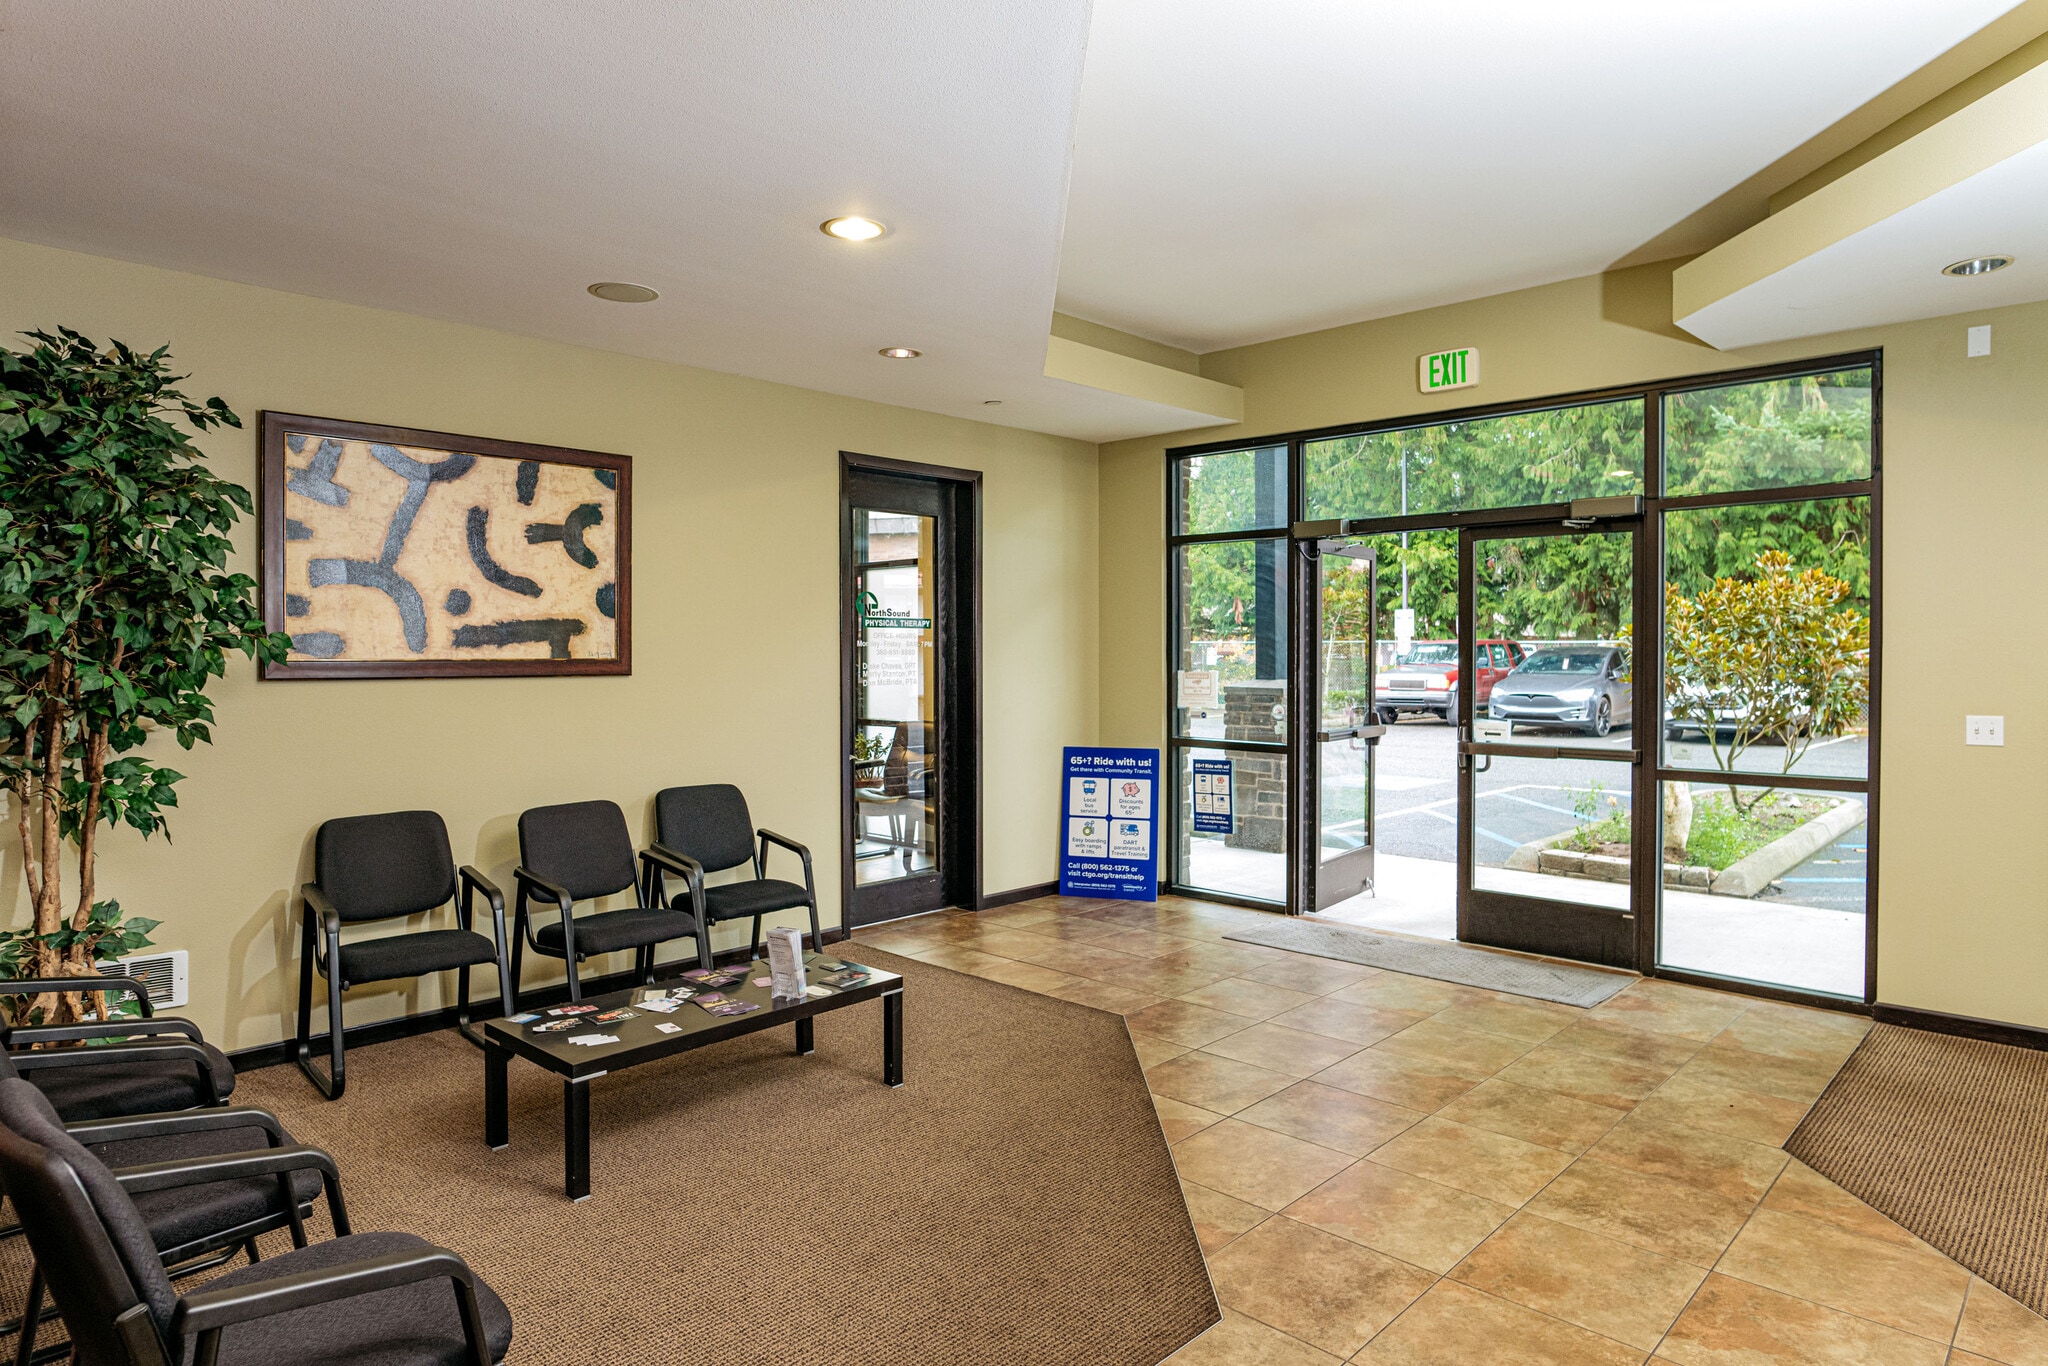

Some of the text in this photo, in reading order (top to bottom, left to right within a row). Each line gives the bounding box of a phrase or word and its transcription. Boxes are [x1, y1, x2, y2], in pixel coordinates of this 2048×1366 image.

[1429, 350, 1469, 388] EXIT
[864, 603, 911, 617] NorthSound
[865, 619, 931, 628] PHYSICAL THERAPY
[1070, 756, 1152, 767] 65+? Ride with us!
